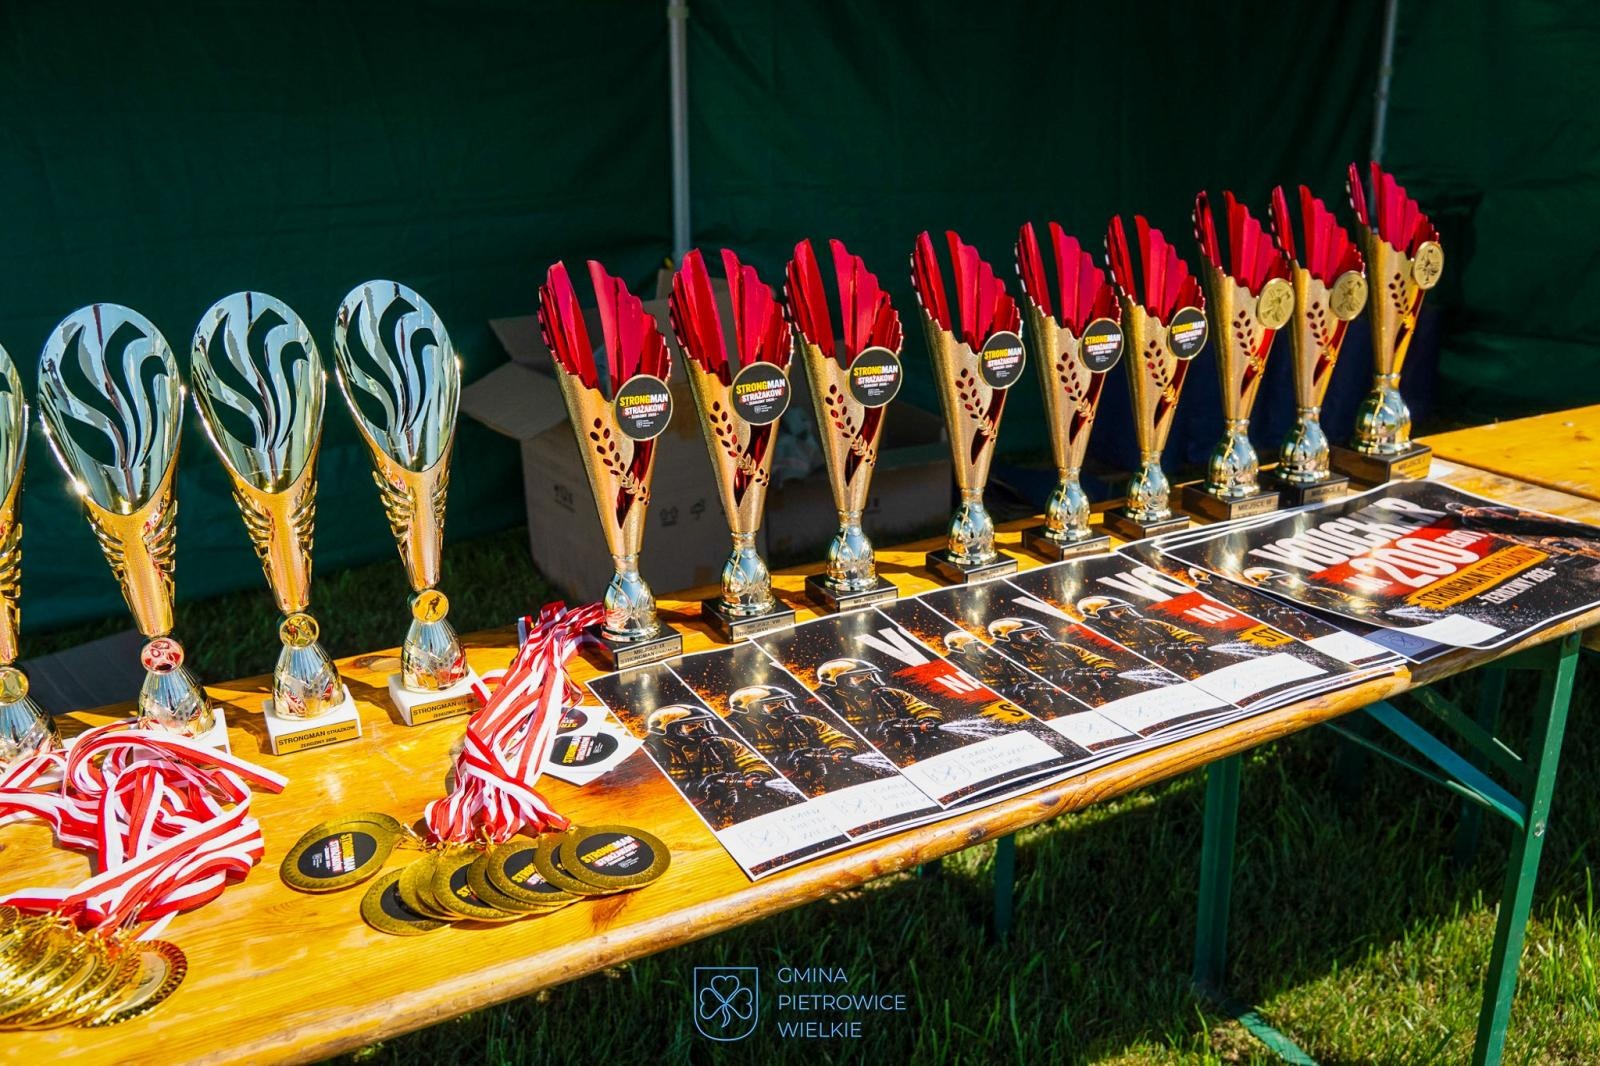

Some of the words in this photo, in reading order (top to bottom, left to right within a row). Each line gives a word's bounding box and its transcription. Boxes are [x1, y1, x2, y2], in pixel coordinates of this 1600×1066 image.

[853, 365, 899, 377] STRONGMAN
[736, 379, 786, 395] STRONGMAN
[741, 388, 783, 404] STRAŻAKÓW
[619, 393, 669, 407] STRONGMAN
[624, 402, 665, 416] STRAŻAKÓW
[1247, 497, 1448, 573] VOUCHER
[1348, 537, 1481, 589] 200
[1416, 570, 1496, 605] STRONGMAN
[1182, 604, 1238, 625] NA
[412, 697, 458, 717] STRONGMAN
[277, 729, 327, 747] STRONGMAN
